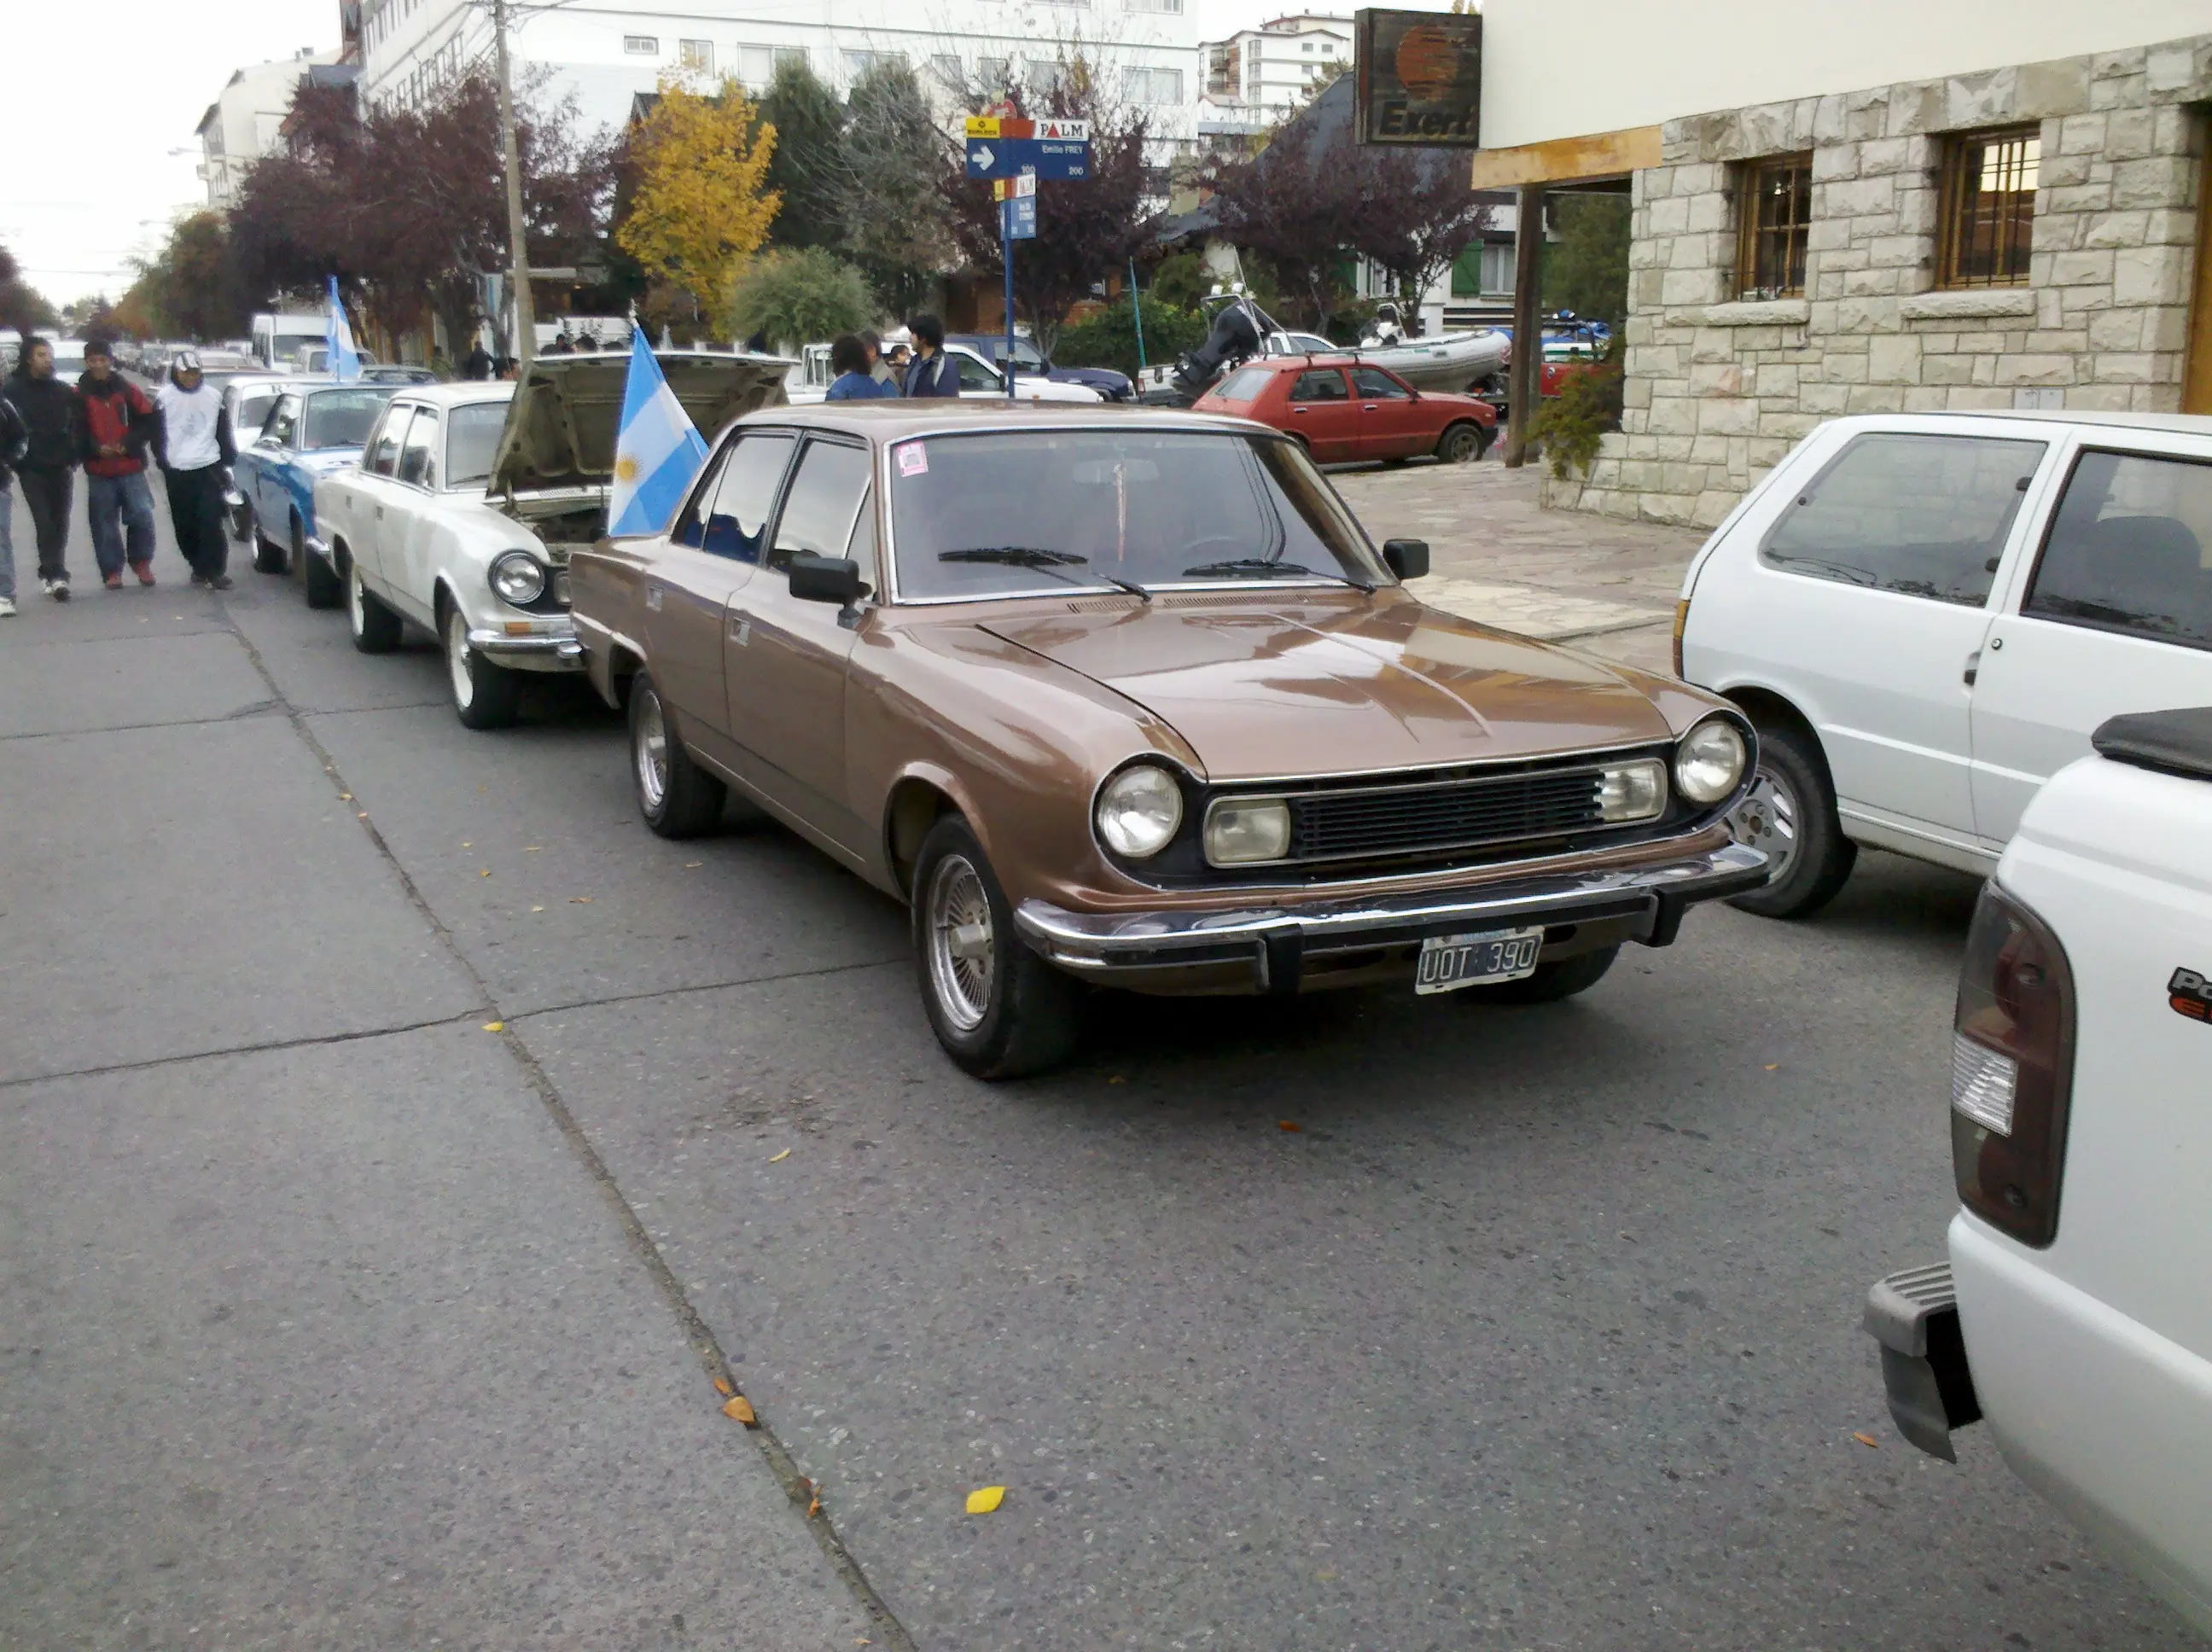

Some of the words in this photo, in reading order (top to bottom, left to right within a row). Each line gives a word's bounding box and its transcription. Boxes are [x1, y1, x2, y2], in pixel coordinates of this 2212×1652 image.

[1040, 122, 1084, 137] PALM
[1064, 145, 1084, 154] FREY
[1068, 166, 1084, 176] 200
[1487, 939, 1536, 973] 390
